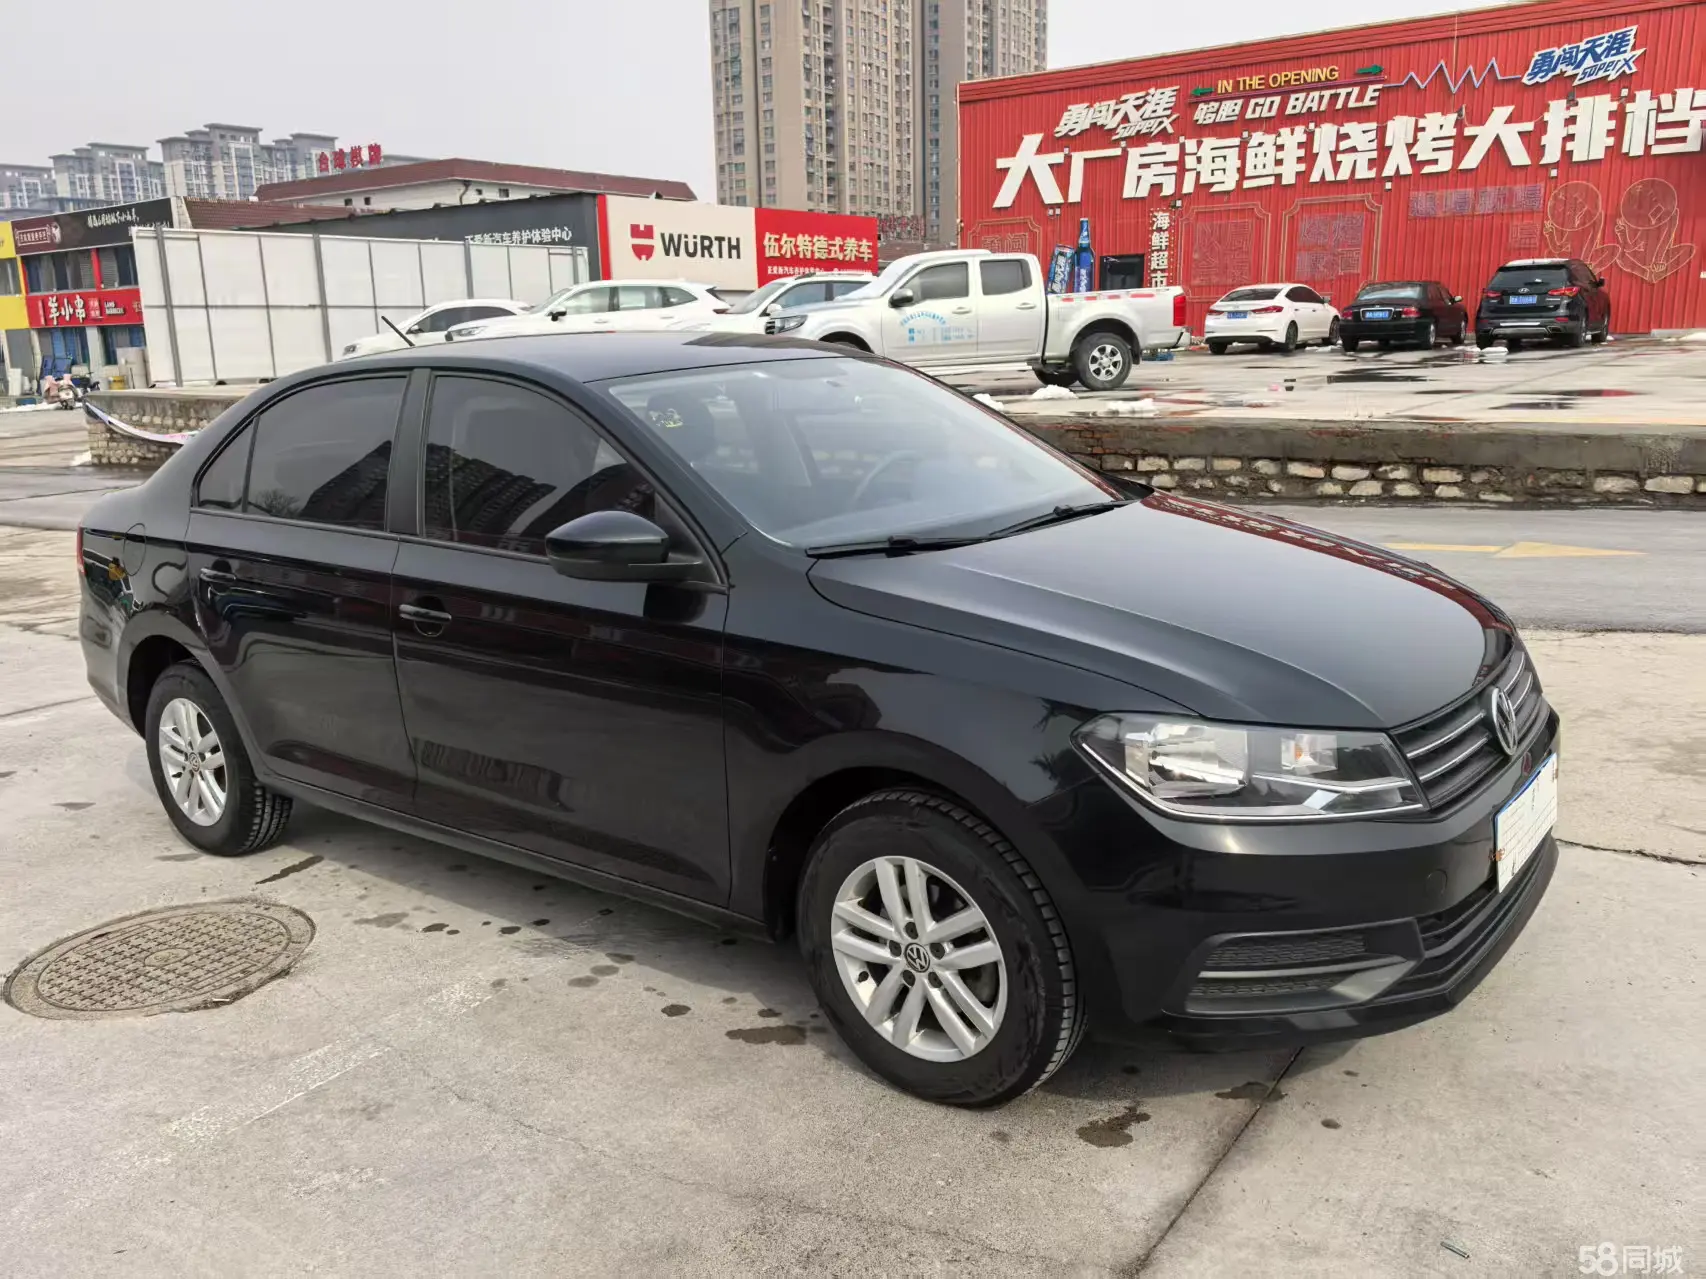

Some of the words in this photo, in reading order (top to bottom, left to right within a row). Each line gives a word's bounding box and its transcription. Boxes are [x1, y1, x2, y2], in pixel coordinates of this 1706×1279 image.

[1526, 28, 1634, 81] 勇闯天涯
[1217, 79, 1232, 94] IN
[1237, 75, 1265, 91] THE
[1269, 66, 1339, 87] OPENING
[1054, 86, 1180, 137] 勇闯天涯
[1193, 99, 1243, 125] 够胆
[1245, 96, 1281, 120] GO
[1285, 84, 1383, 116] BATTLE
[992, 87, 1706, 208] 大厂房海鲜烧烤大排档
[660, 232, 741, 260] WÜRTH
[763, 231, 873, 262] 伍尔特德式养车
[1151, 211, 1170, 288] 海鲜超市
[48, 294, 86, 326] 羊小串
